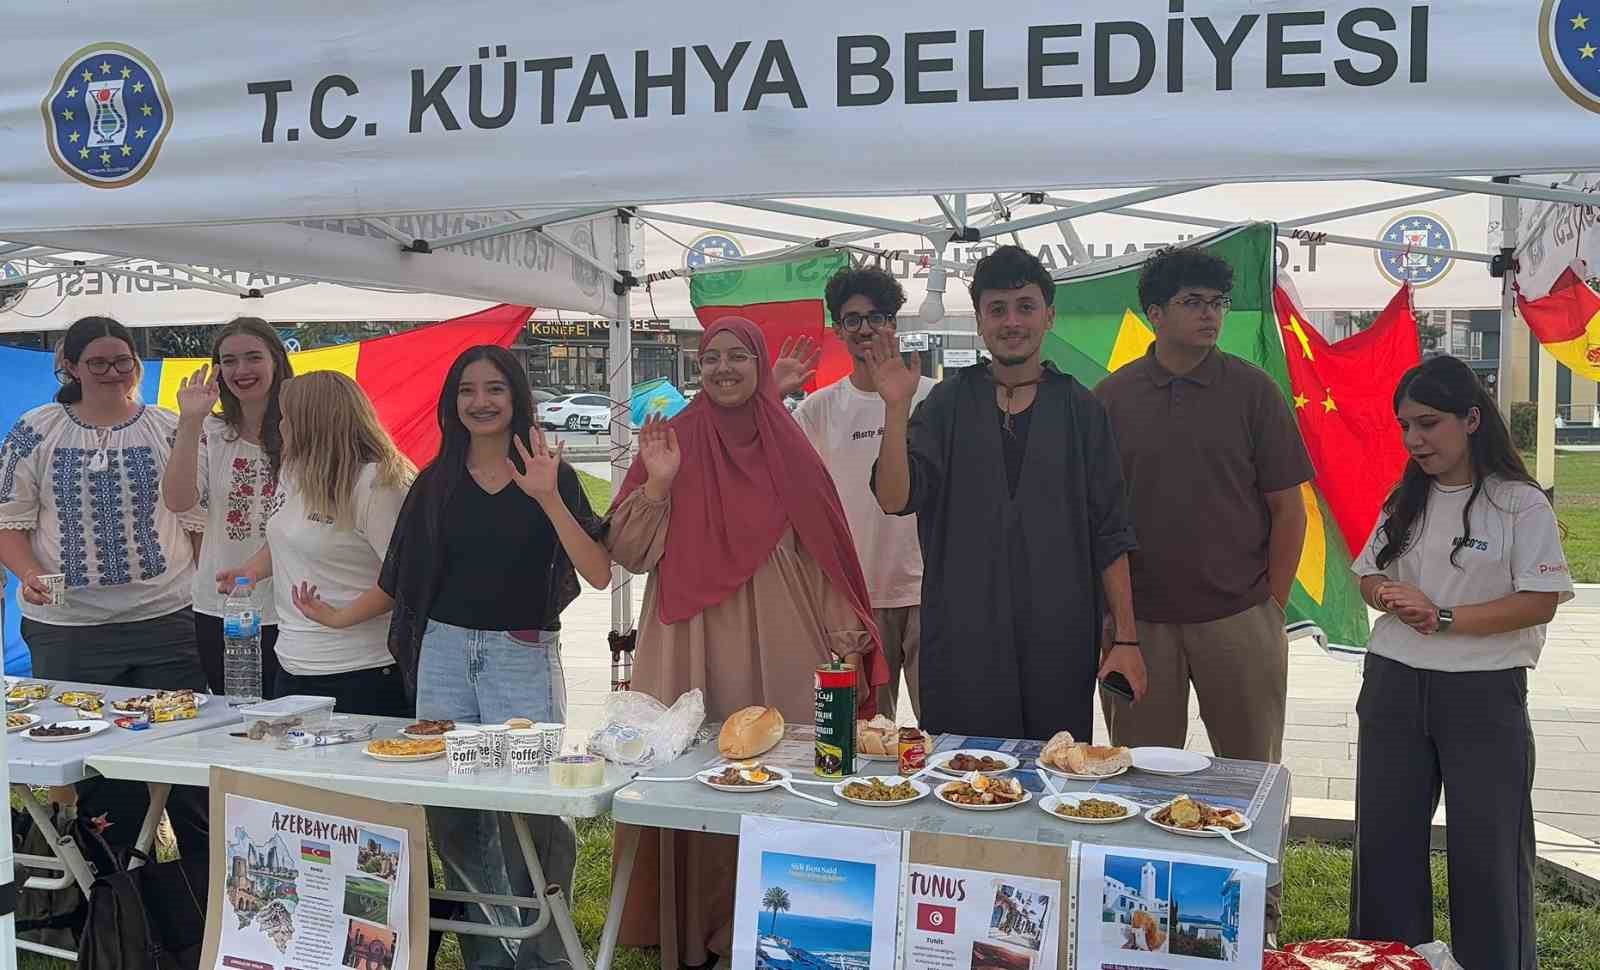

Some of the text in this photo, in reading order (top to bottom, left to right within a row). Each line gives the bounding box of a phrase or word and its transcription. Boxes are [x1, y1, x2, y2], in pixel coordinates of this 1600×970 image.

[247, 74, 378, 143] T.C.
[409, 39, 808, 134] KÜTAHYA
[272, 811, 358, 845] AZERBAYCAN
[910, 871, 967, 902] TUNUS
